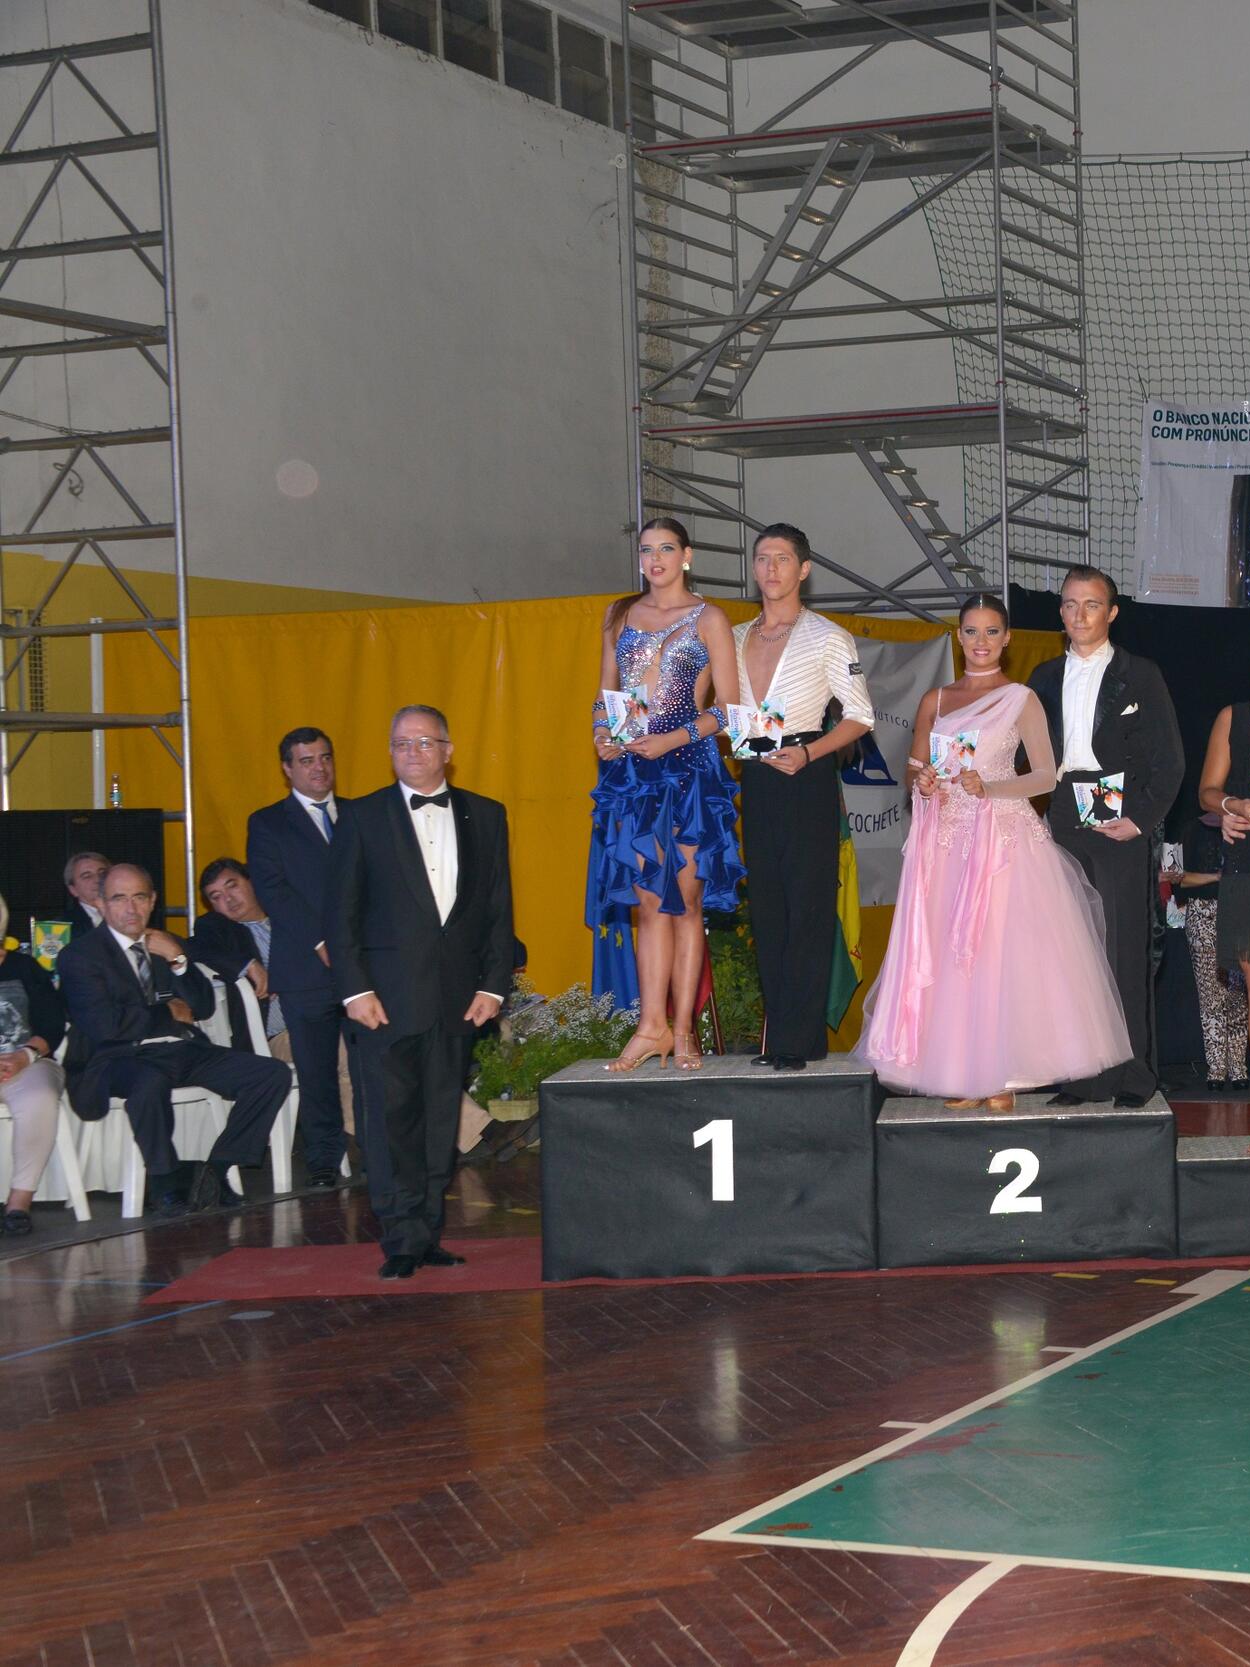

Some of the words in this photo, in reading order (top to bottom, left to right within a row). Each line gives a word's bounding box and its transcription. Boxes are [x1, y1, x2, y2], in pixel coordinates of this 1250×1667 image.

[1151, 426, 1183, 441] COM
[1153, 409, 1164, 423] O
[1166, 410, 1210, 426] BANCO
[691, 1119, 735, 1202] 1
[985, 1148, 1042, 1214] 2
